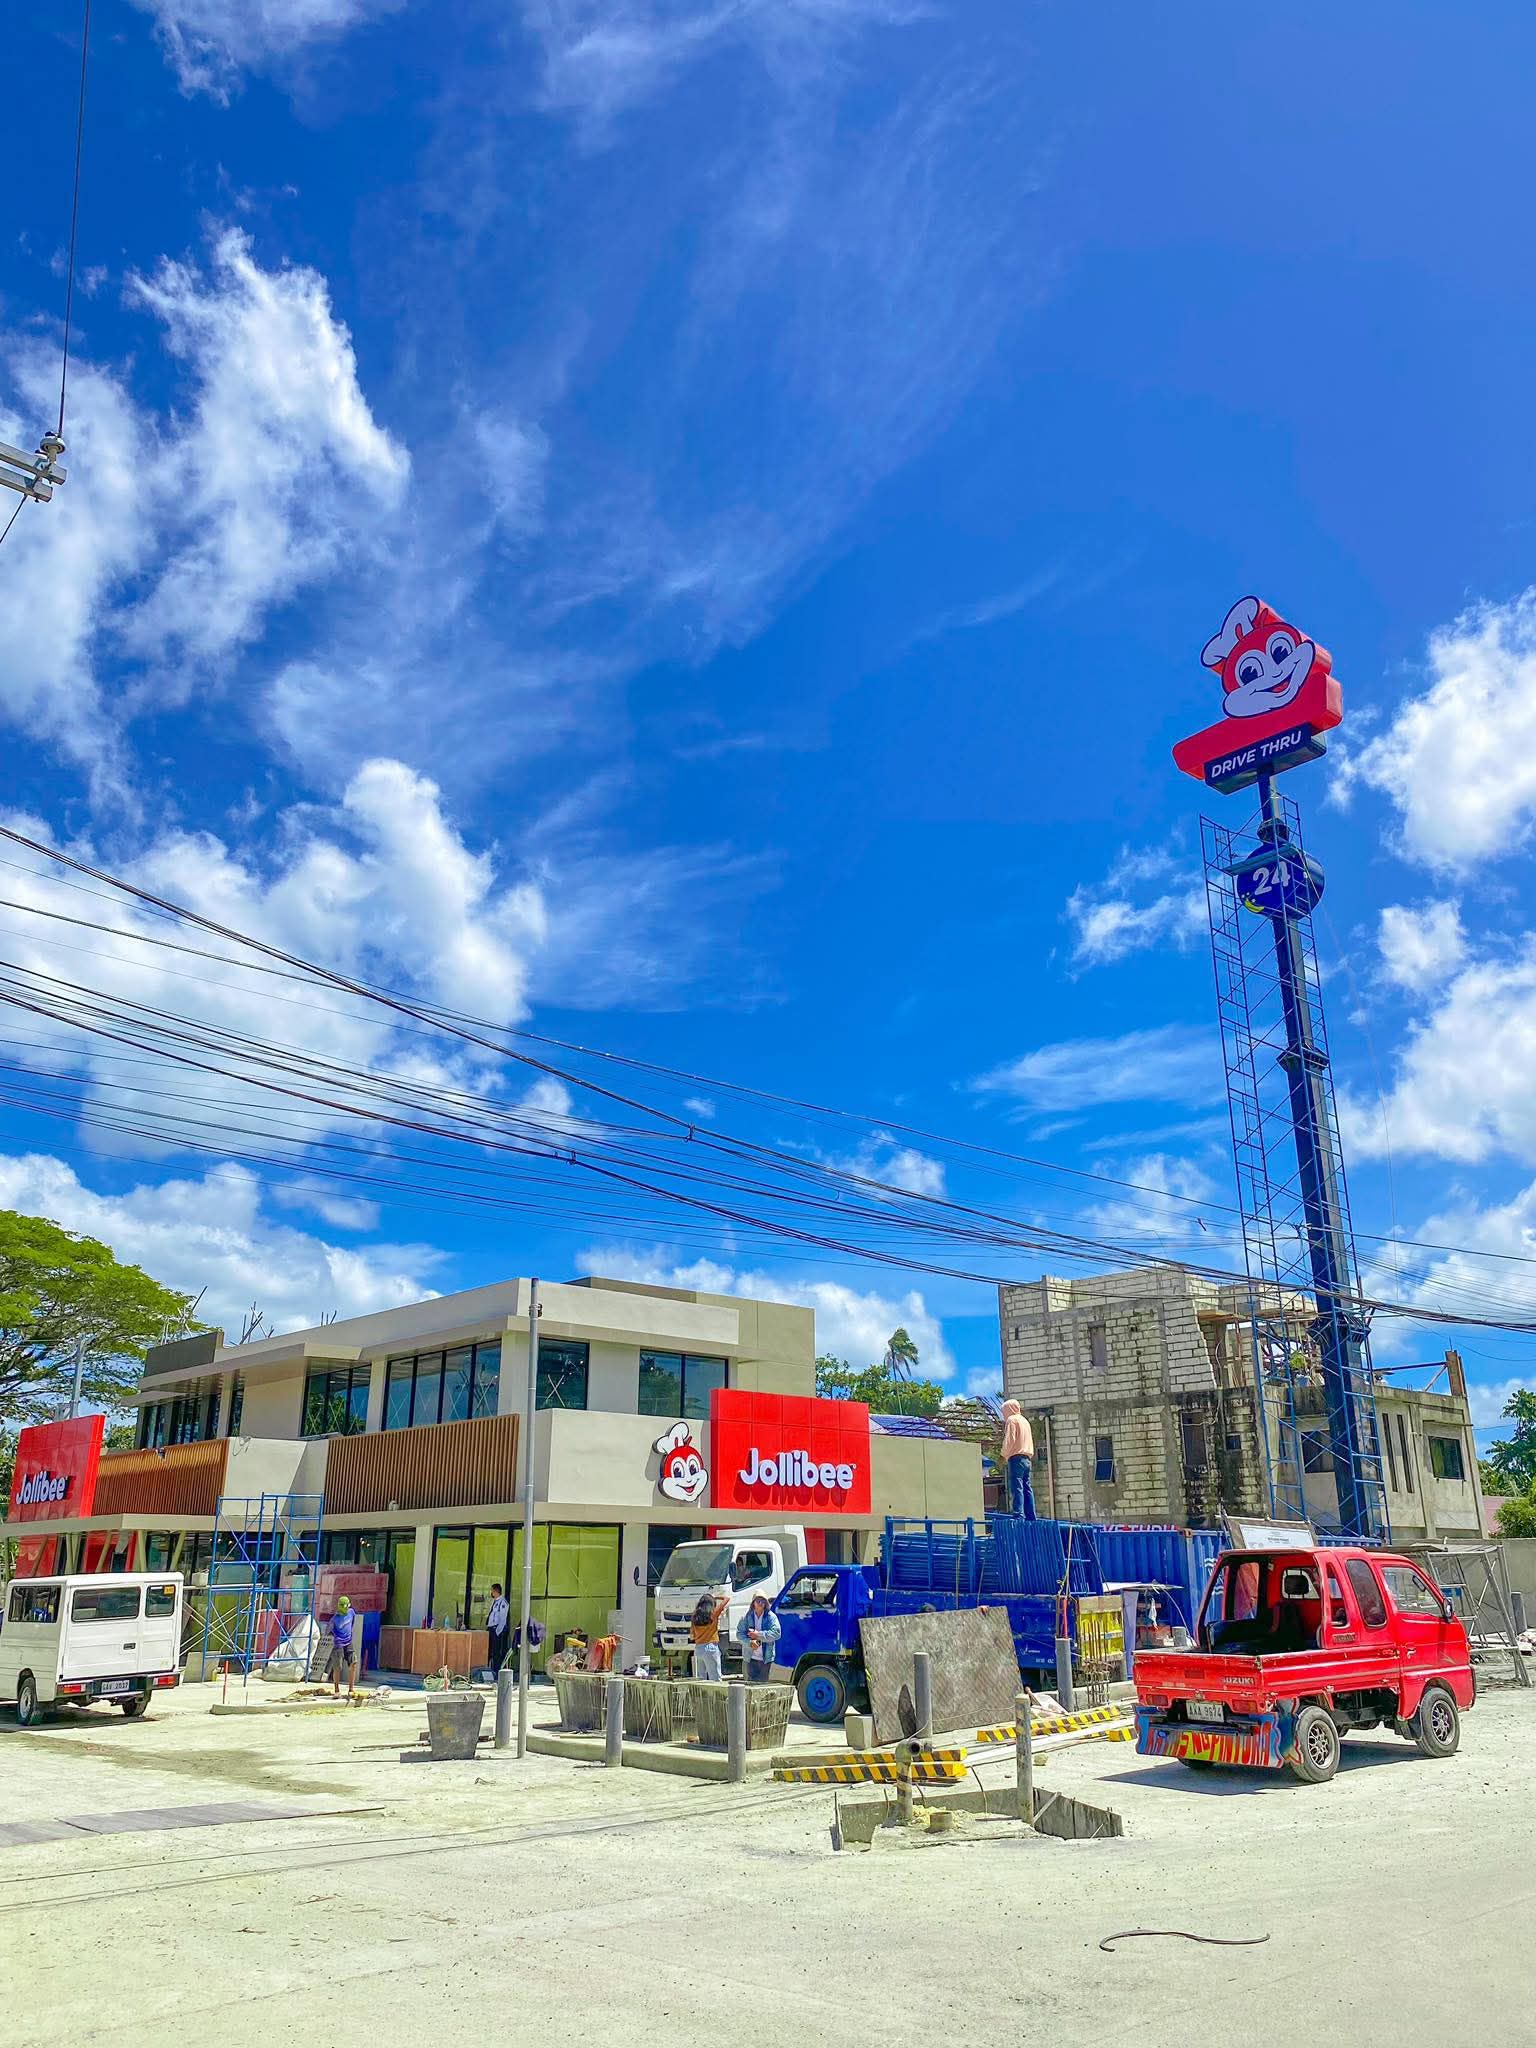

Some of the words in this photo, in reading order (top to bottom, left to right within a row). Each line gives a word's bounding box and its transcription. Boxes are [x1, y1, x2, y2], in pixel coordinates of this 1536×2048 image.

[1211, 748, 1257, 778] DRIVE
[1260, 730, 1302, 758] THRU
[1252, 860, 1291, 896] 24
[15, 1470, 68, 1505] Jollibee
[738, 1447, 854, 1490] Jollibee
